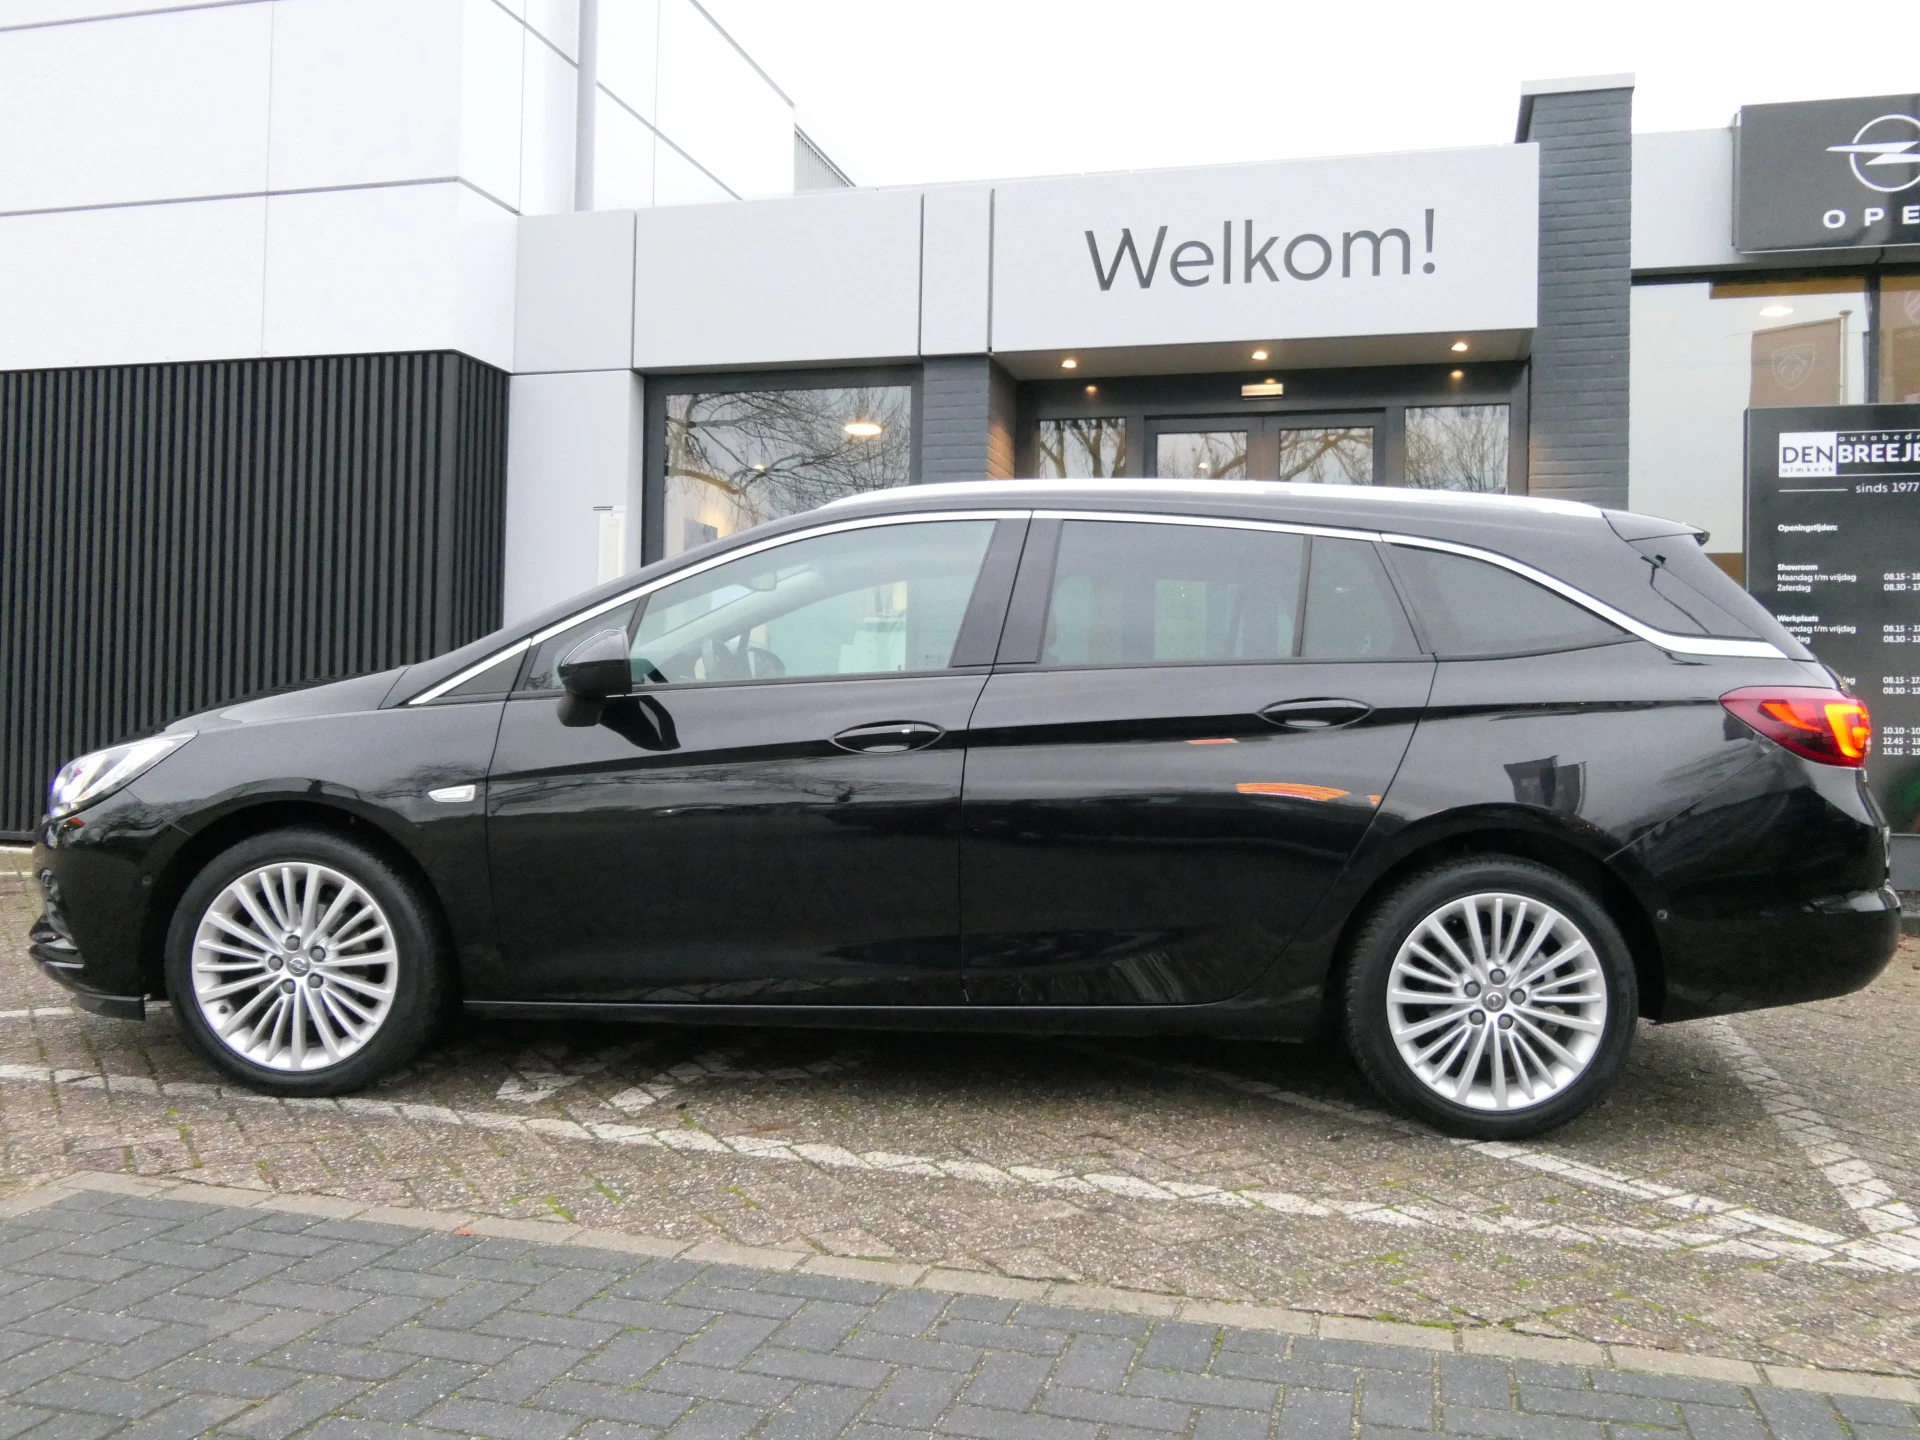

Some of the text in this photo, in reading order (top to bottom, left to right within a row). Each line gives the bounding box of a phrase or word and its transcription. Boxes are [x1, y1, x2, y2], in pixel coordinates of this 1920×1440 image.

[1823, 205, 1920, 229] OPE
[1084, 208, 1436, 291] Welkom!
[1782, 445, 1833, 464] DEN
[1855, 482, 1920, 493] sinds 1977
[1777, 523, 1838, 532] Openingstijden:
[1777, 563, 1818, 571] Showroom
[1777, 574, 1813, 582] Maandag
[1829, 573, 1857, 582] vrijdag
[1883, 572, 1906, 581] 08.15
[1777, 584, 1811, 592] Zaterdag
[1883, 583, 1907, 591] 08.30
[1777, 614, 1819, 623] Werkplaats
[1785, 625, 1813, 634] andag
[1829, 625, 1857, 634] vrijdag
[1883, 624, 1905, 632] 08.15
[1883, 635, 1906, 643] 08.30
[1882, 676, 1905, 684] 08.15
[1882, 686, 1906, 695] 08.30
[1882, 726, 1905, 735] 10.10
[1882, 737, 1904, 745] 12.45
[1882, 747, 1904, 756] 15.15
